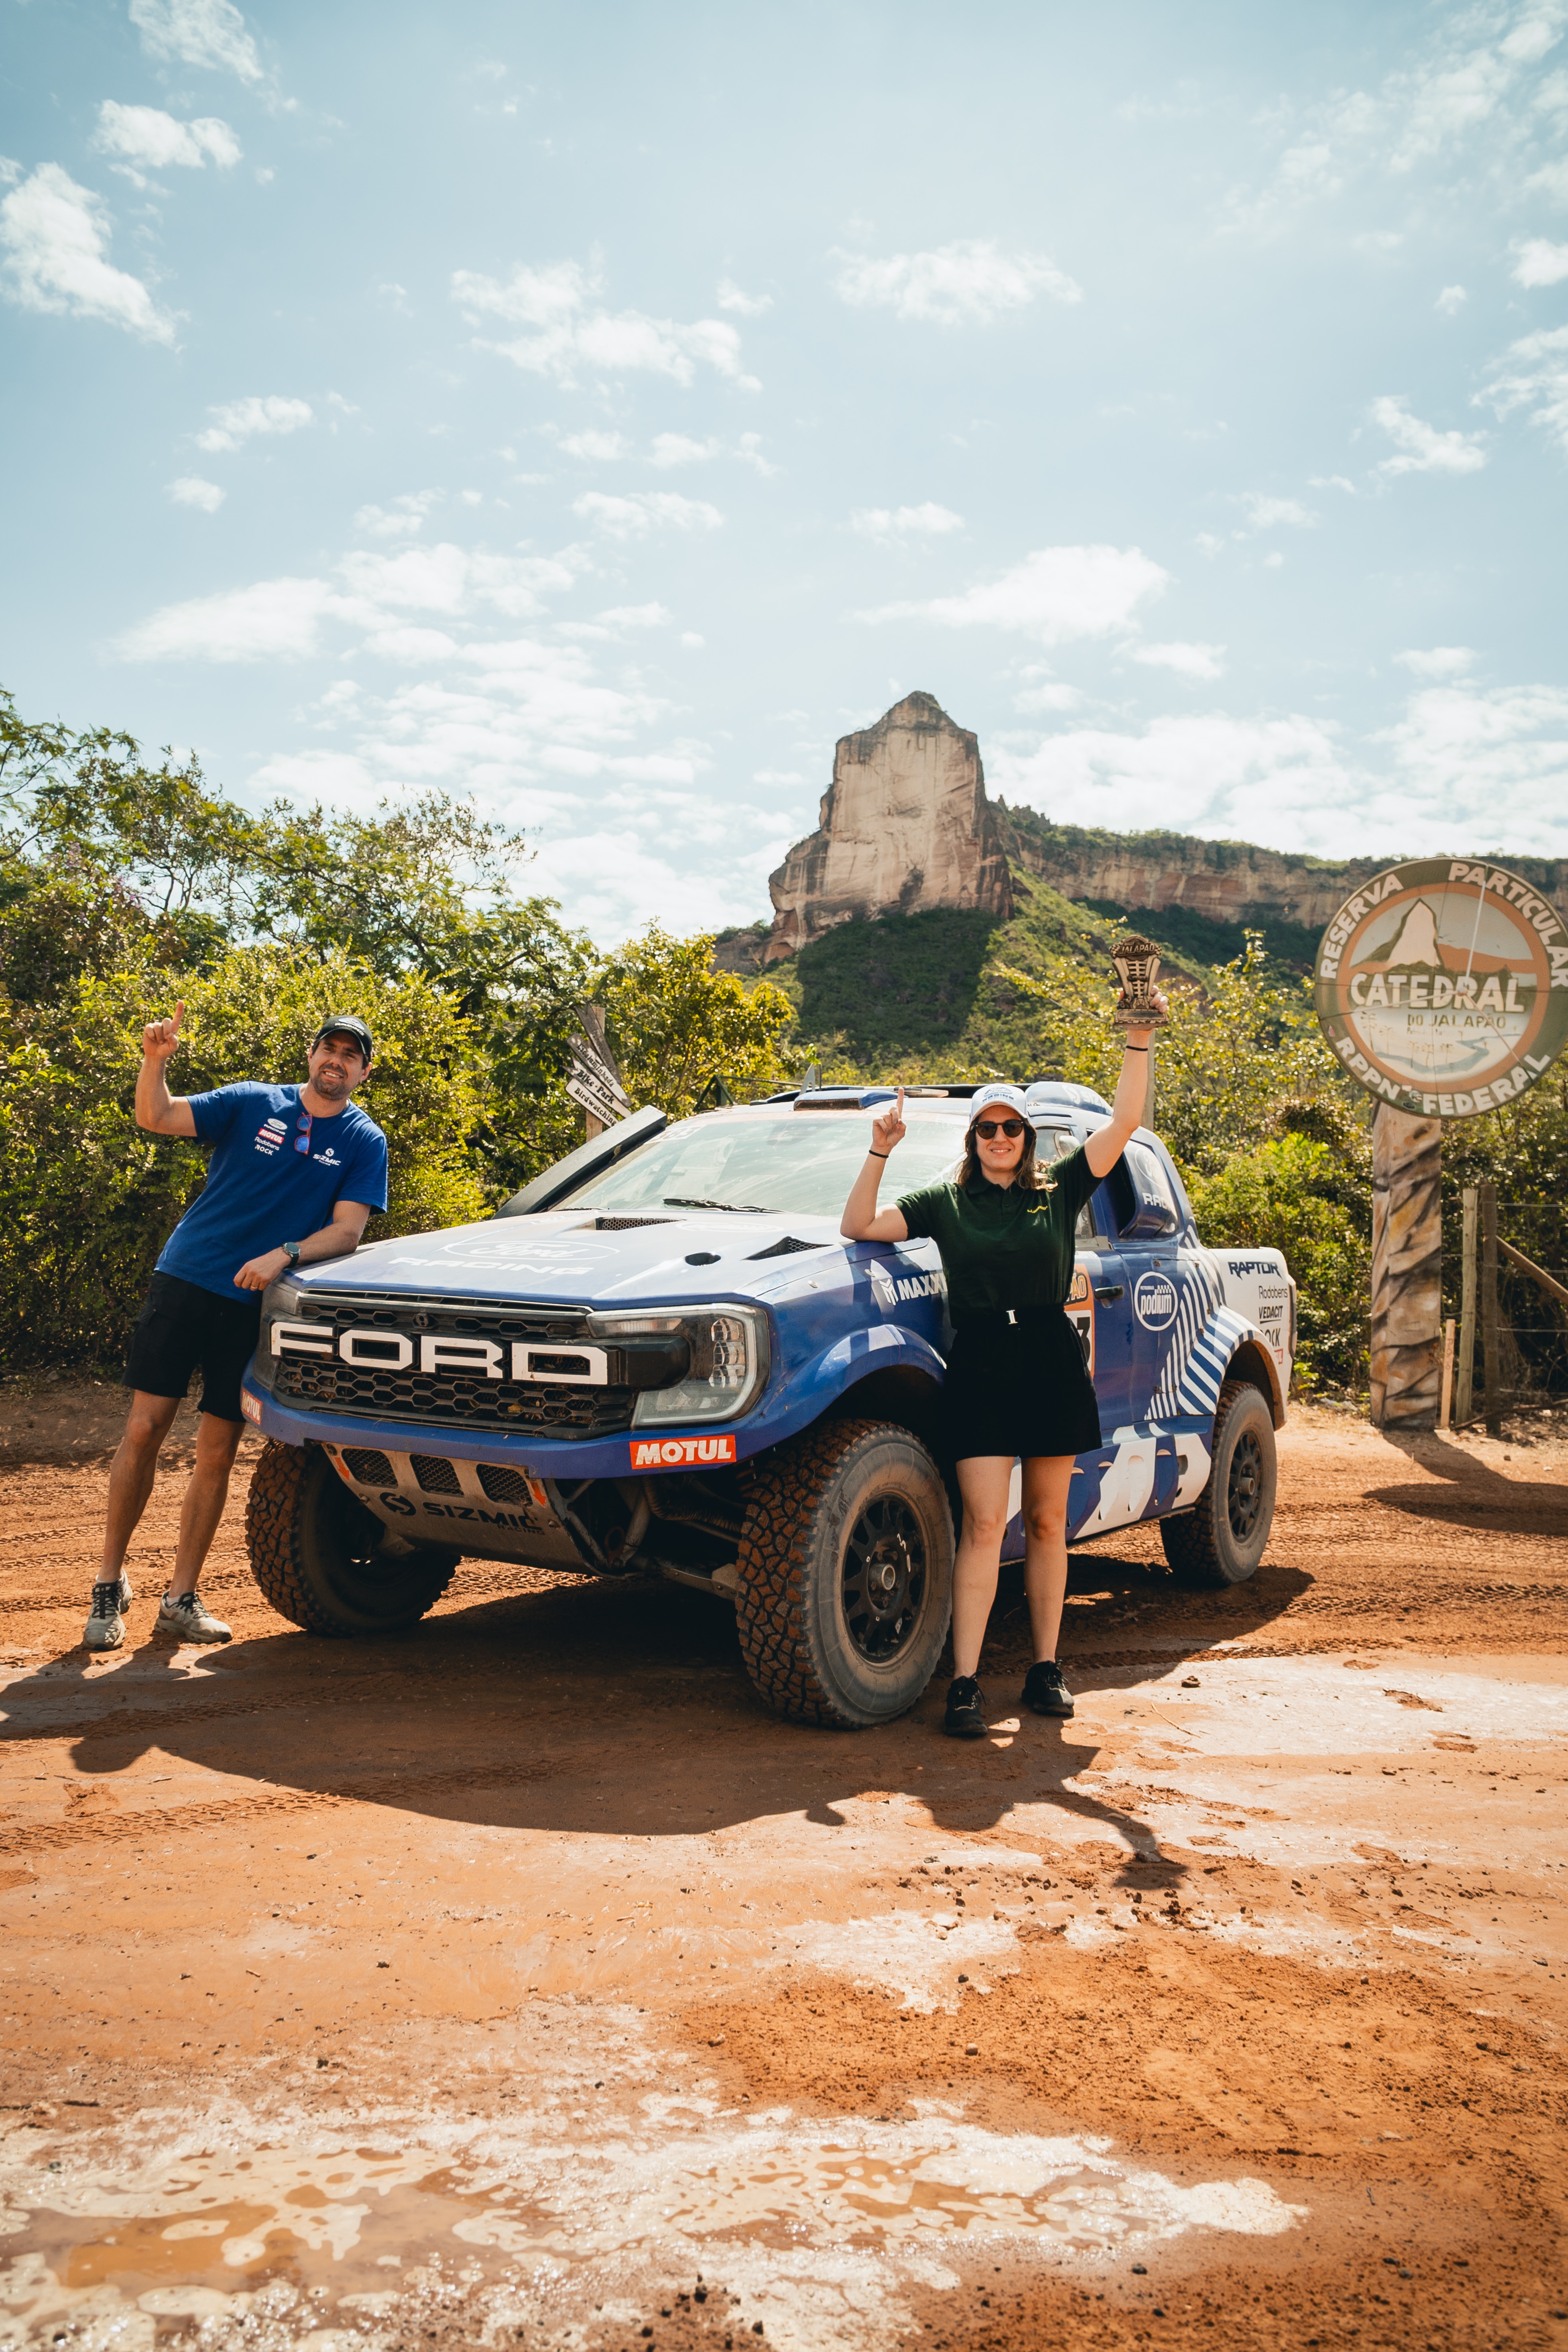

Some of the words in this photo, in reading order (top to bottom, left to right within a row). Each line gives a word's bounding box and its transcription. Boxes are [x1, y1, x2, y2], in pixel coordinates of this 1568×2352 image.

[1320, 873, 1404, 979] RESERVA
[1448, 862, 1568, 988] PARTICULAR
[1351, 973, 1524, 1013] CATEDRAL
[335, 1023, 364, 1036] RACING
[1407, 1014, 1424, 1026] DO
[1336, 1036, 1401, 1100] RPPN
[577, 1070, 594, 1087] Bike
[596, 1086, 614, 1105] Park
[1423, 1053, 1550, 1115] FEDERAL
[574, 1087, 616, 1127] Birdwatching
[254, 1136, 280, 1151] Rodobens
[259, 1129, 283, 1144] MOTUL
[255, 1144, 273, 1156] ROCK
[313, 1154, 341, 1166] SIZMIC
[470, 1242, 591, 1258] Ford
[388, 1257, 594, 1275] RACING
[1228, 1261, 1283, 1281] RAPTOR
[897, 1272, 948, 1301] MAXXI
[1258, 1285, 1288, 1299] Rodobens
[1140, 1289, 1172, 1318] podium
[1259, 1305, 1283, 1319] VEDACIT
[1260, 1328, 1281, 1347] OCK
[271, 1322, 608, 1385] FORD
[242, 1392, 261, 1422] MOTUL
[635, 1439, 732, 1465] MOTUL
[423, 1502, 543, 1530] SIZMIC
[497, 1524, 545, 1536] RACING
